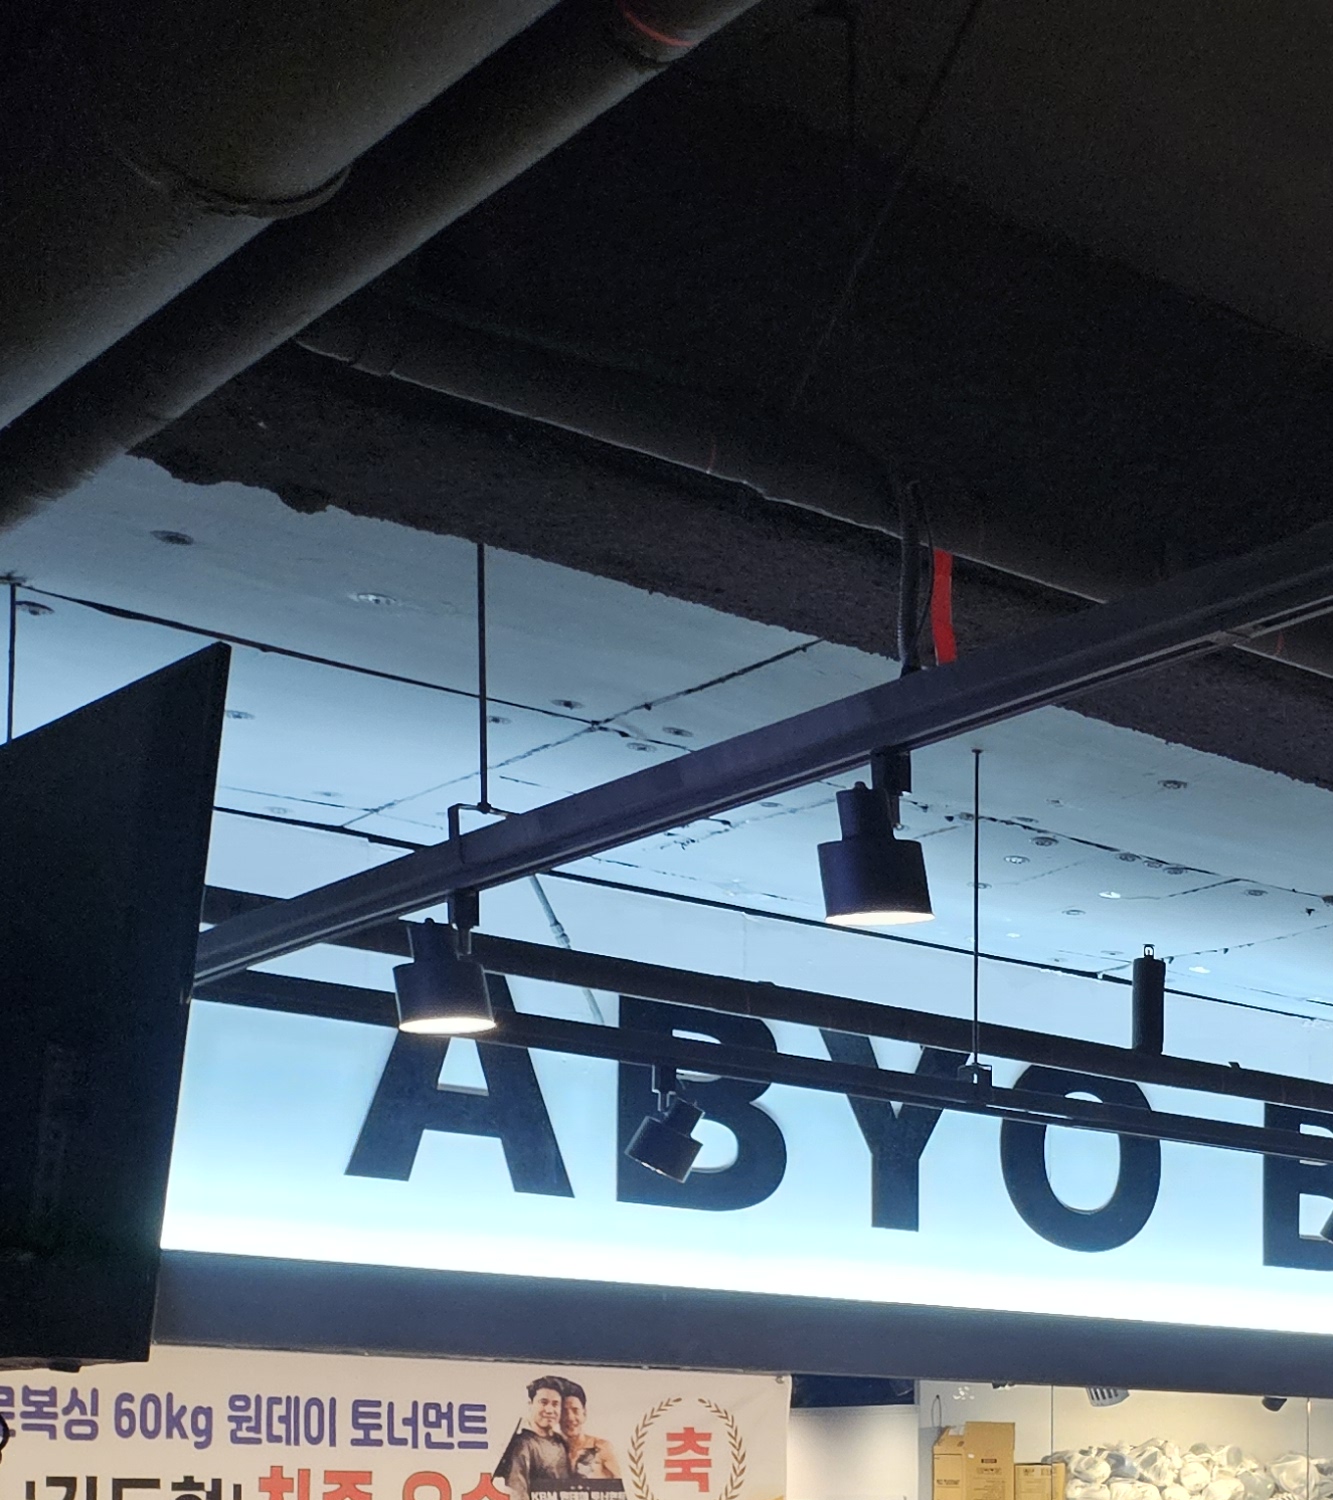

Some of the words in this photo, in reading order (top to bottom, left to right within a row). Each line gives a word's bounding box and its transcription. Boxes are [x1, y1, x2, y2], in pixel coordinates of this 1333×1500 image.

[345, 970, 1162, 1252] ABYO
[114, 1393, 213, 1449] 60kg
[227, 1394, 337, 1448] 원데이
[350, 1399, 489, 1450] 토너먼트
[664, 1427, 712, 1492] 축
